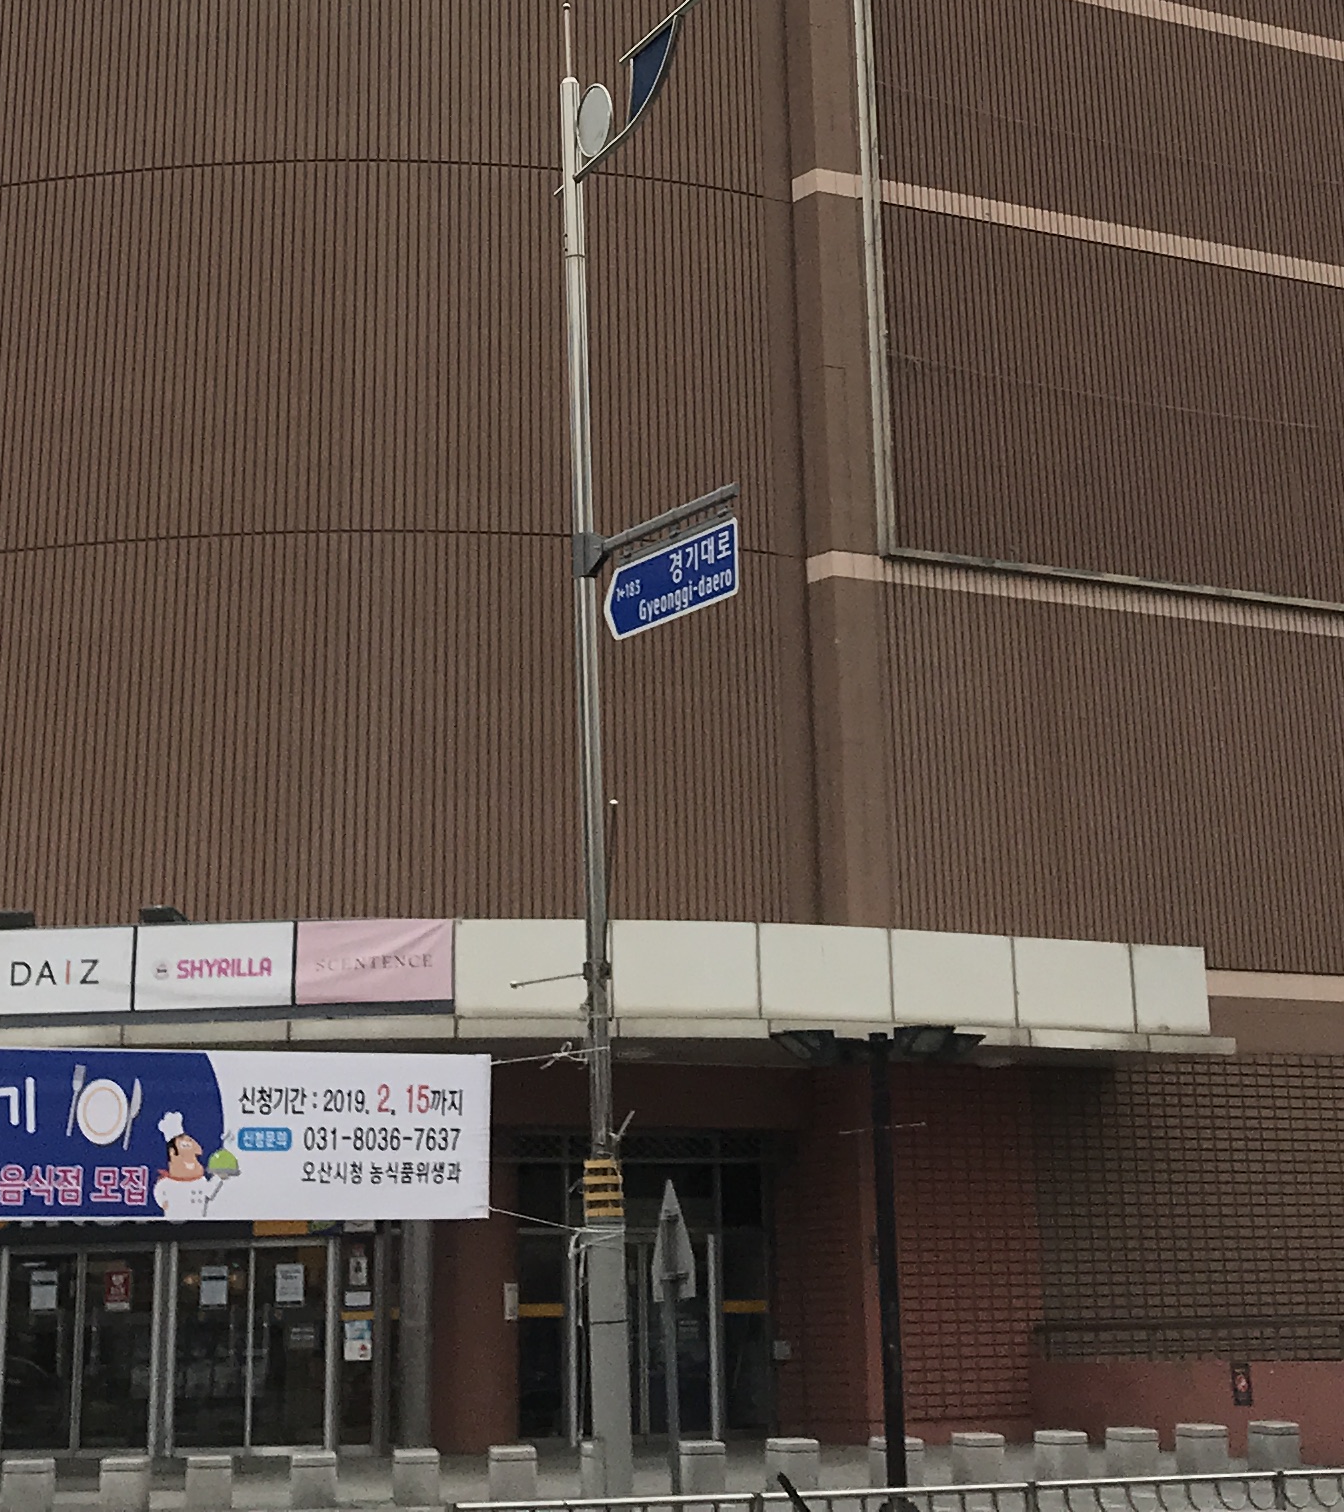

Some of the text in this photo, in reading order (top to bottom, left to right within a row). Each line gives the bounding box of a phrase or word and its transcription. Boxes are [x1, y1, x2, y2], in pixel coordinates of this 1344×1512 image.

[668, 530, 732, 584] 경기대로
[638, 568, 733, 622] Gyeonggi-daero
[9, 958, 100, 987] DAIZ
[176, 956, 273, 980] SHYRILLA
[238, 1086, 307, 1115] 신청기간
[323, 1088, 369, 1115] 2019.
[376, 1084, 397, 1116] 2.
[304, 1126, 462, 1152] 031-8036-7637
[90, 1164, 149, 1207] 모집
[301, 1161, 462, 1185] 오산시청 농식품위생과
